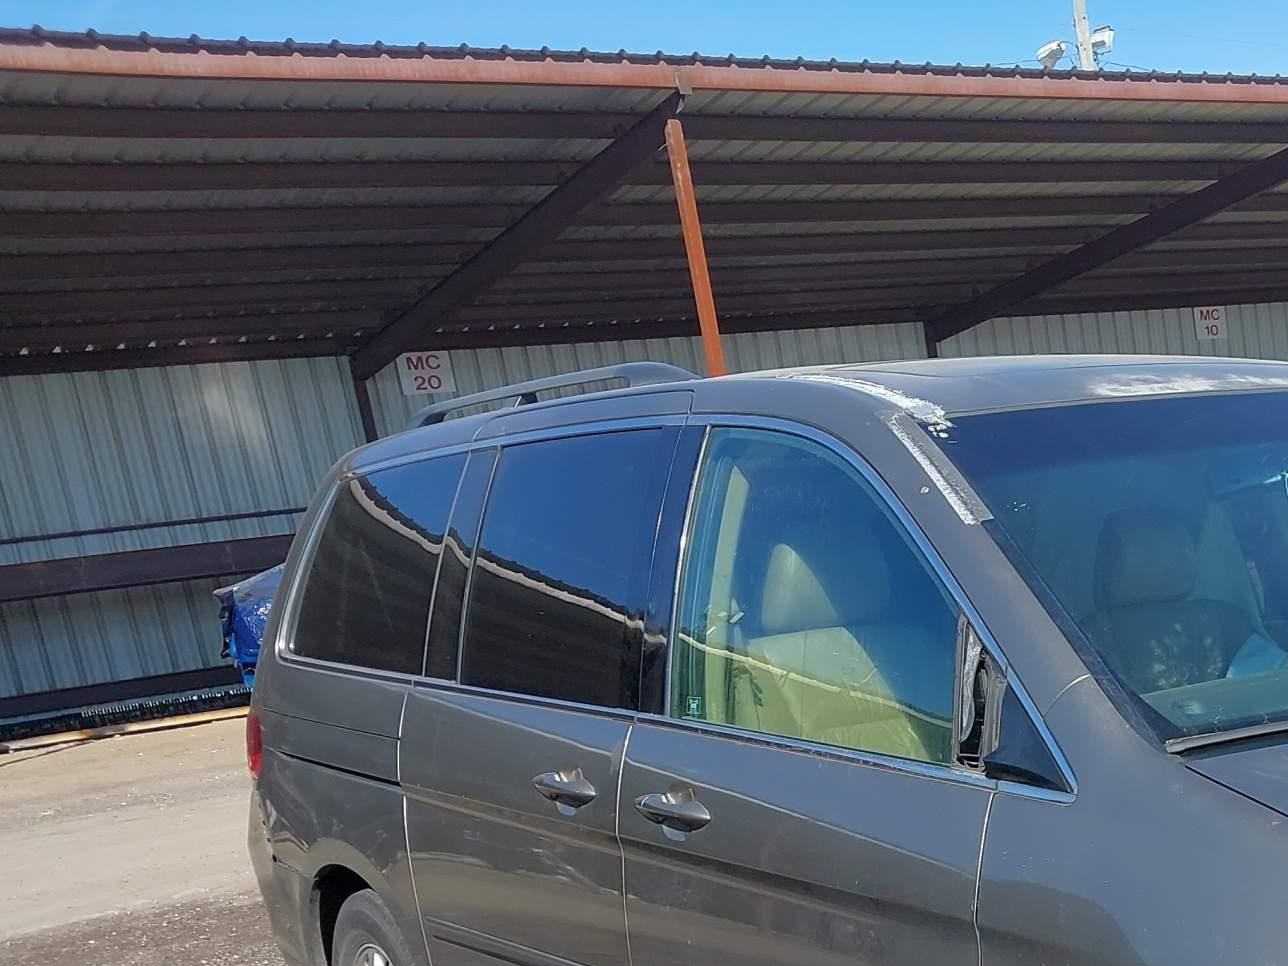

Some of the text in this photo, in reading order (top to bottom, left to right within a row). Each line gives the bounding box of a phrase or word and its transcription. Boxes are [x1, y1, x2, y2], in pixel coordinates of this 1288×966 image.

[1200, 309, 1220, 321] MC
[1204, 324, 1218, 336] 10
[406, 355, 441, 370] MC
[414, 375, 442, 391] 20
